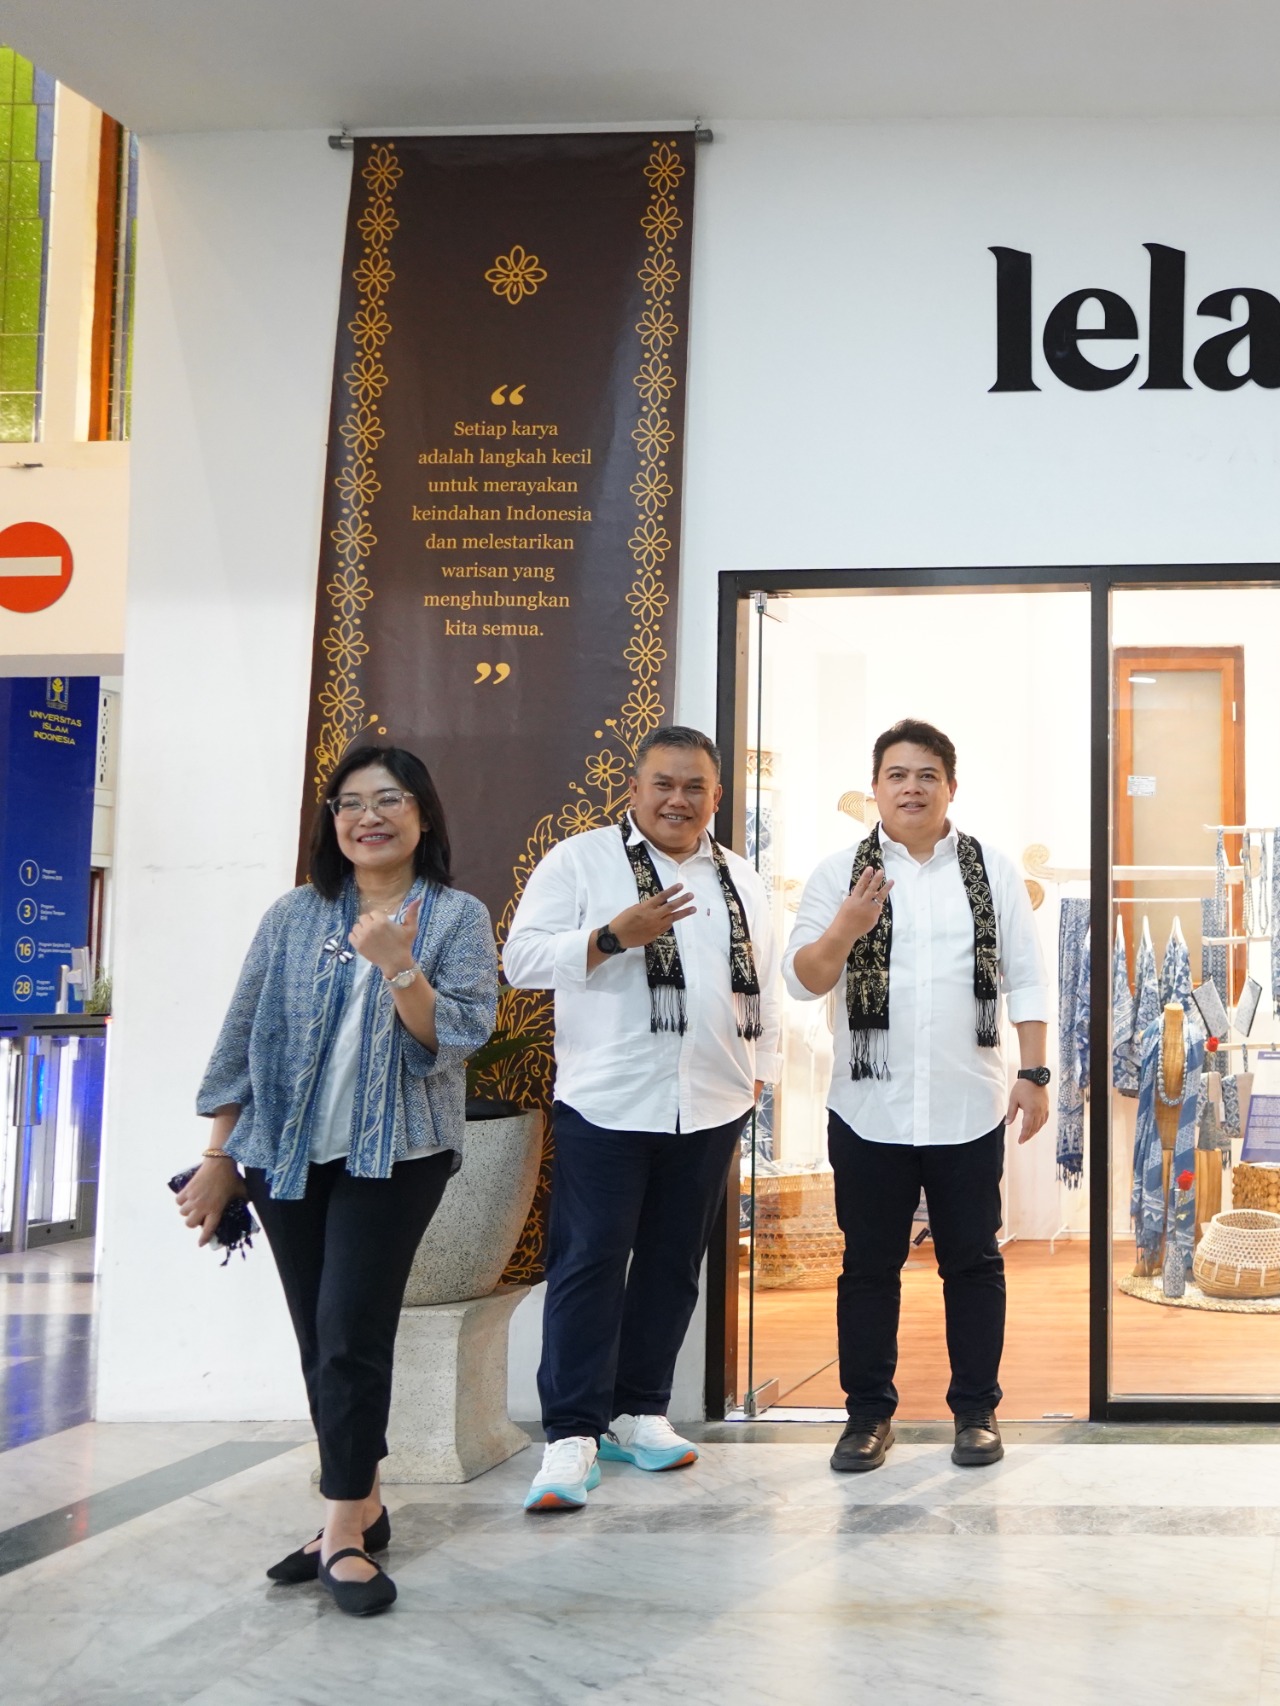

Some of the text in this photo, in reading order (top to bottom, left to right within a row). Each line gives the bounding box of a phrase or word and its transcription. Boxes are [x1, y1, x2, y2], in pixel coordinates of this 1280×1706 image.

[453, 419, 559, 440] Setiap karya
[417, 447, 592, 468] adalah langkah kecil
[427, 476, 578, 497] untuk merayakan
[411, 504, 592, 522] keindahan Indonesia
[424, 532, 574, 550] dan melestarikan
[441, 561, 556, 583] warisan yang
[423, 590, 570, 611] menghubungkan
[444, 619, 544, 637] kita semua.
[29, 709, 82, 727] UNIVERSITAS
[33, 730, 76, 745] INDONESIA
[26, 866, 32, 880] 1
[23, 904, 31, 918] 3
[18, 943, 32, 957] 16
[16, 981, 31, 995] 28
